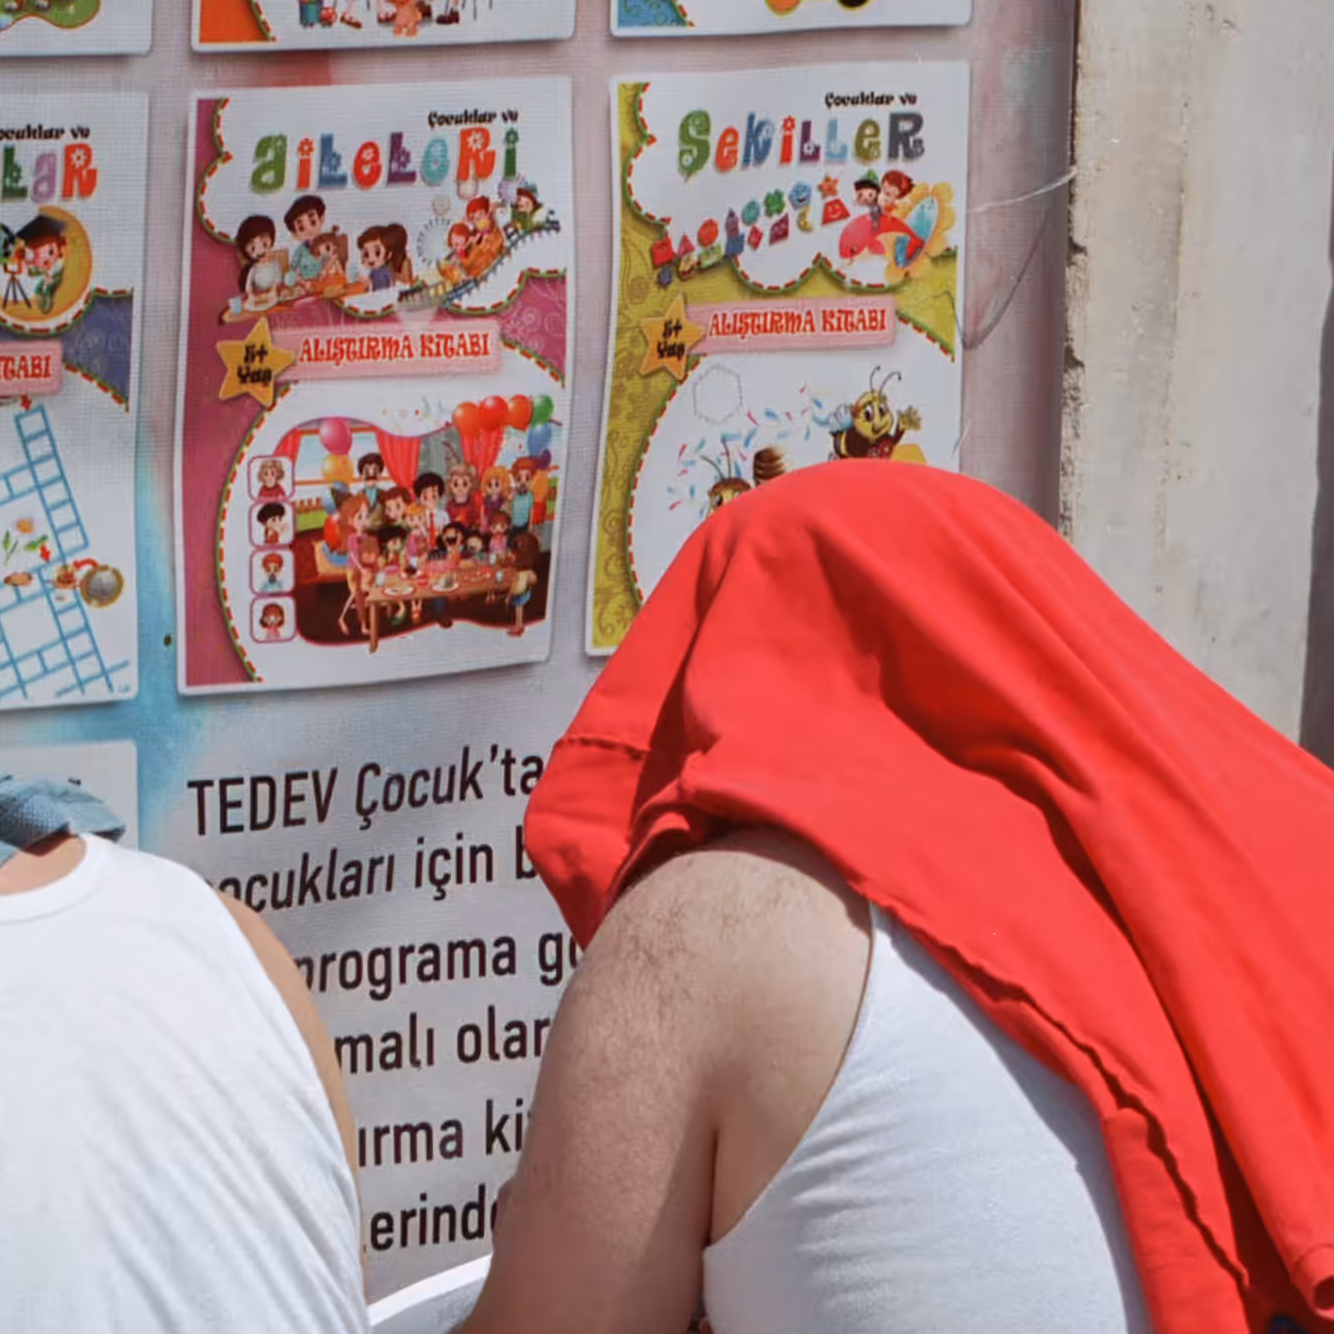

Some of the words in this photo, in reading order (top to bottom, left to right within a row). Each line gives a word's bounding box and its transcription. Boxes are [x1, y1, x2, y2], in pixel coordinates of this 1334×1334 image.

[243, 345, 267, 365] 5+
[662, 321, 683, 339] 5+
[187, 766, 338, 836] TEDEV
[206, 848, 396, 915] ocukları
[414, 832, 494, 901] için
[335, 1011, 436, 1074] malı
[456, 1004, 551, 1064] olar
[358, 1118, 464, 1169] ırma
[484, 1098, 529, 1156] ki
[365, 1183, 498, 1253] erind
